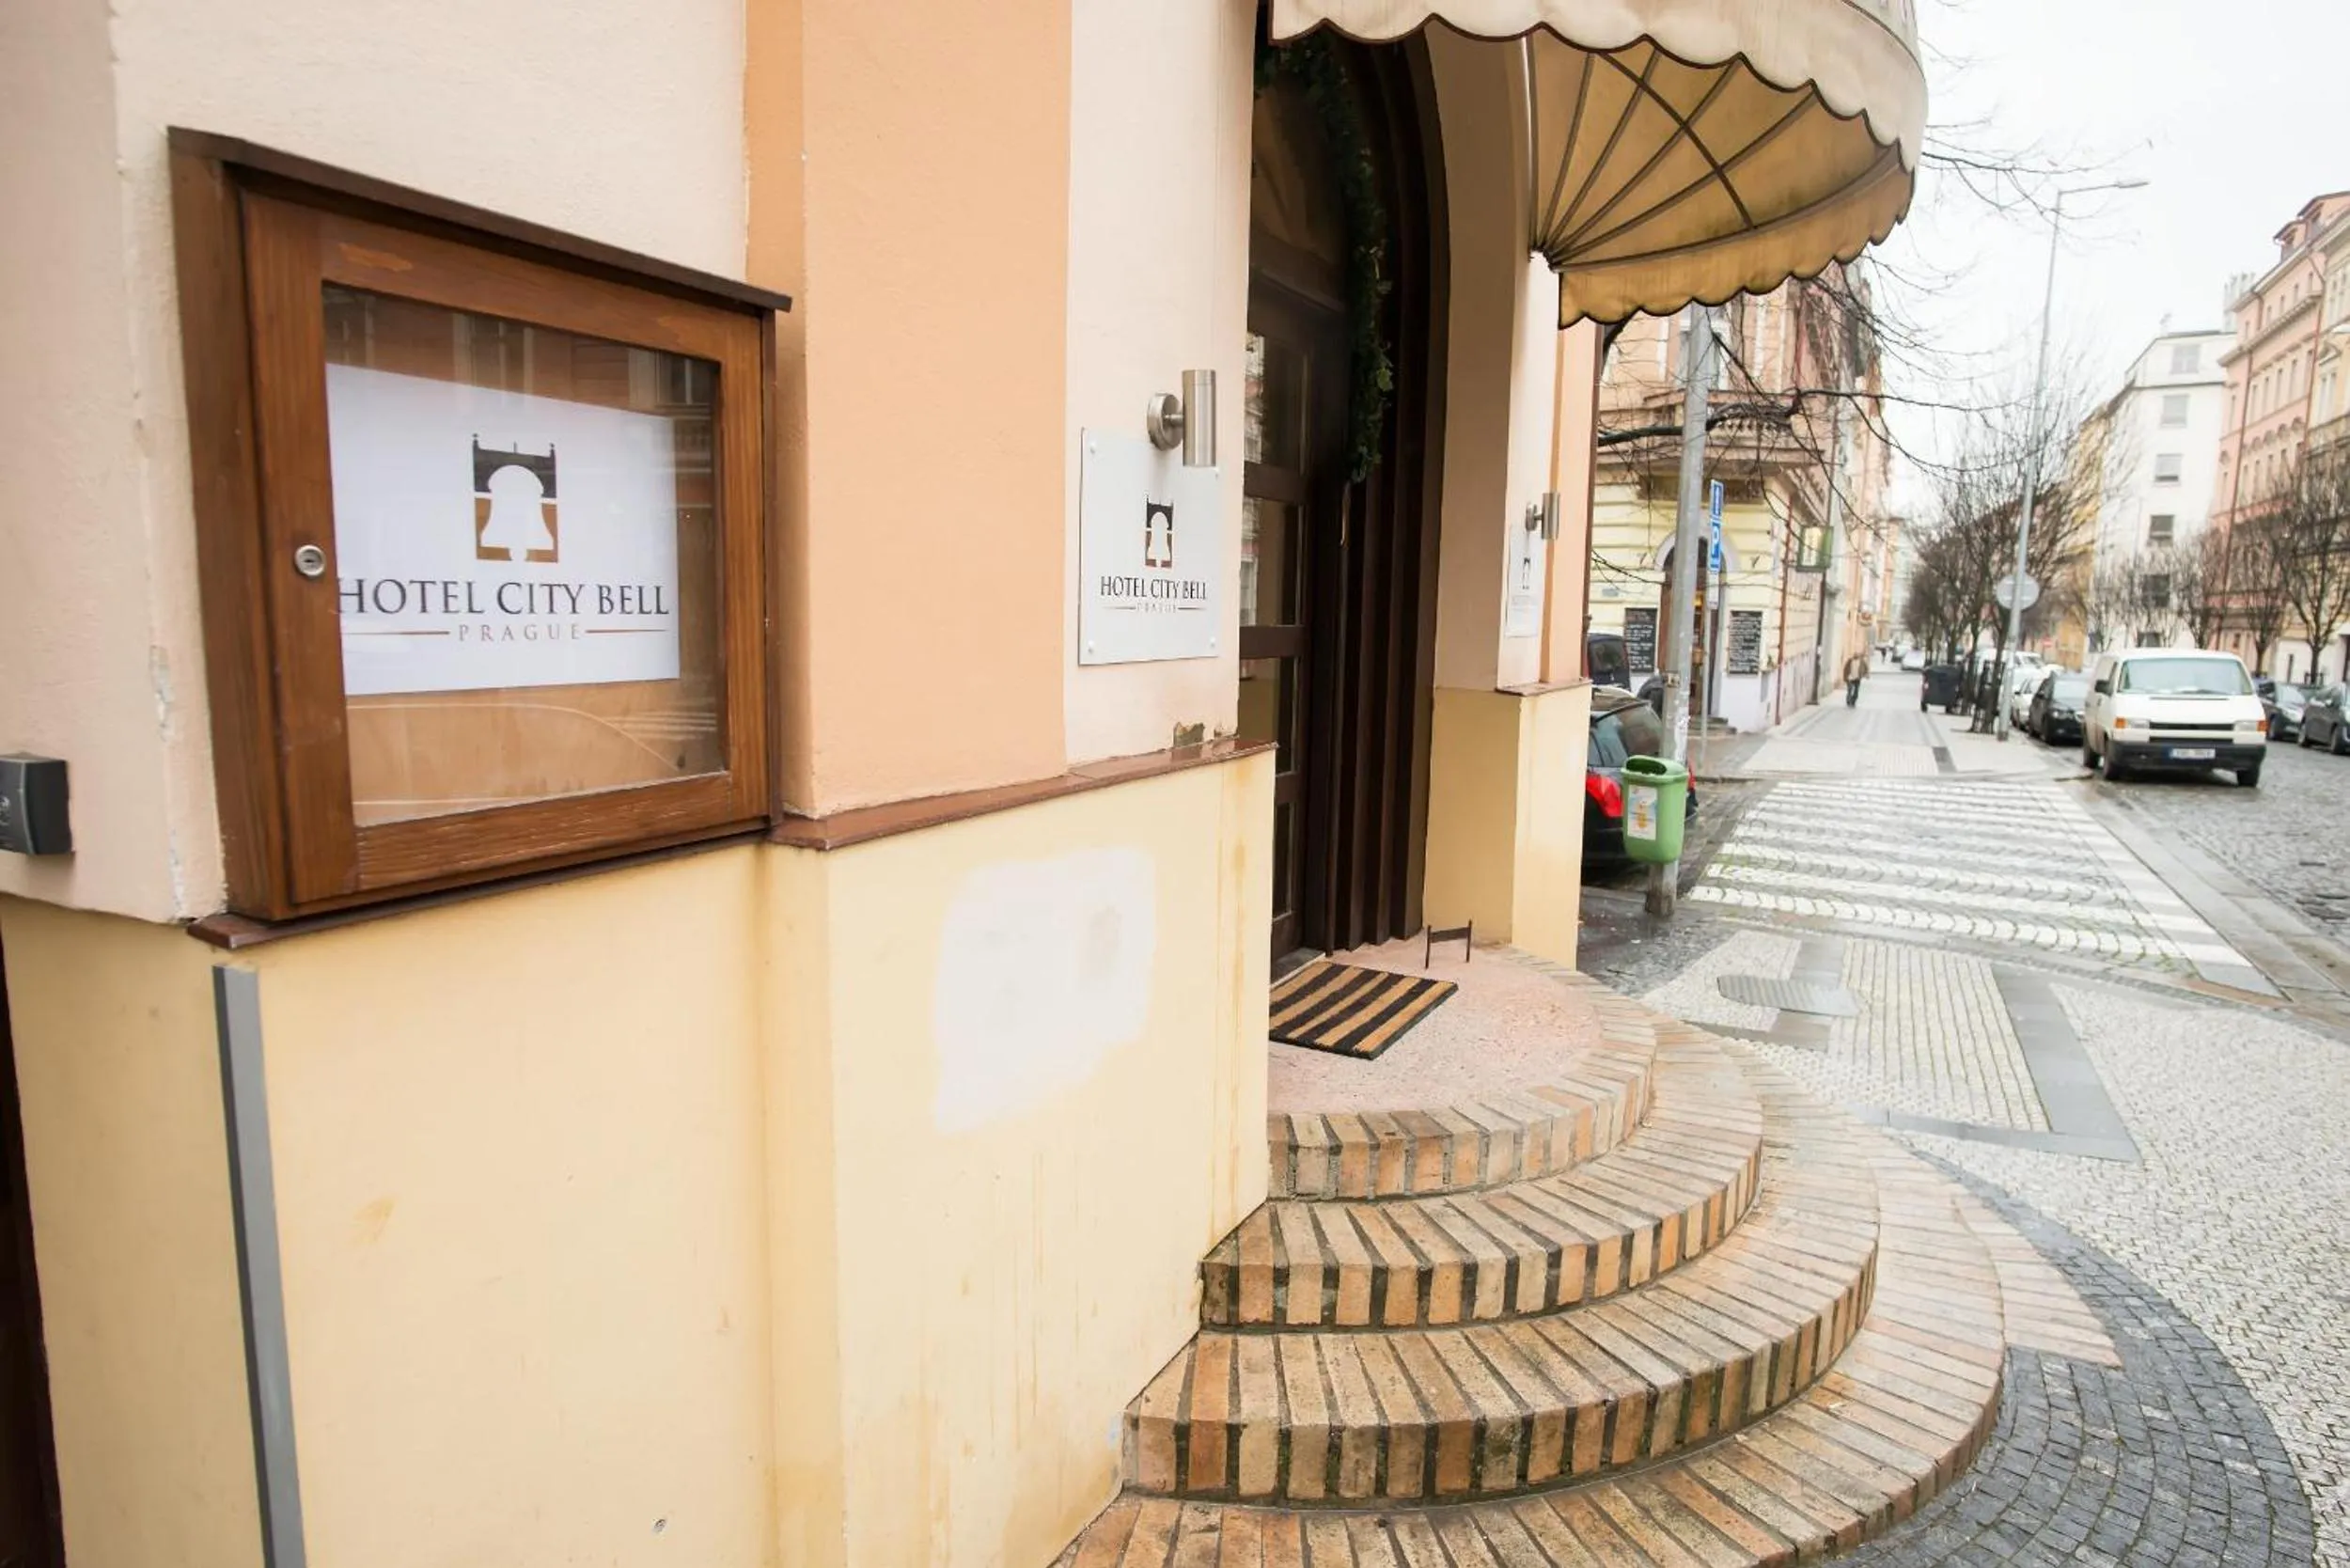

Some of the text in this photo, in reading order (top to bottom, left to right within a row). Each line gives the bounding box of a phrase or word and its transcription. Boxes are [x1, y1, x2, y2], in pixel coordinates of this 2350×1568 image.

[338, 577, 670, 615] HOTEL CITY BELL
[1100, 575, 1207, 600] HOTEL CITY BELL
[458, 623, 581, 642] PRAGUE
